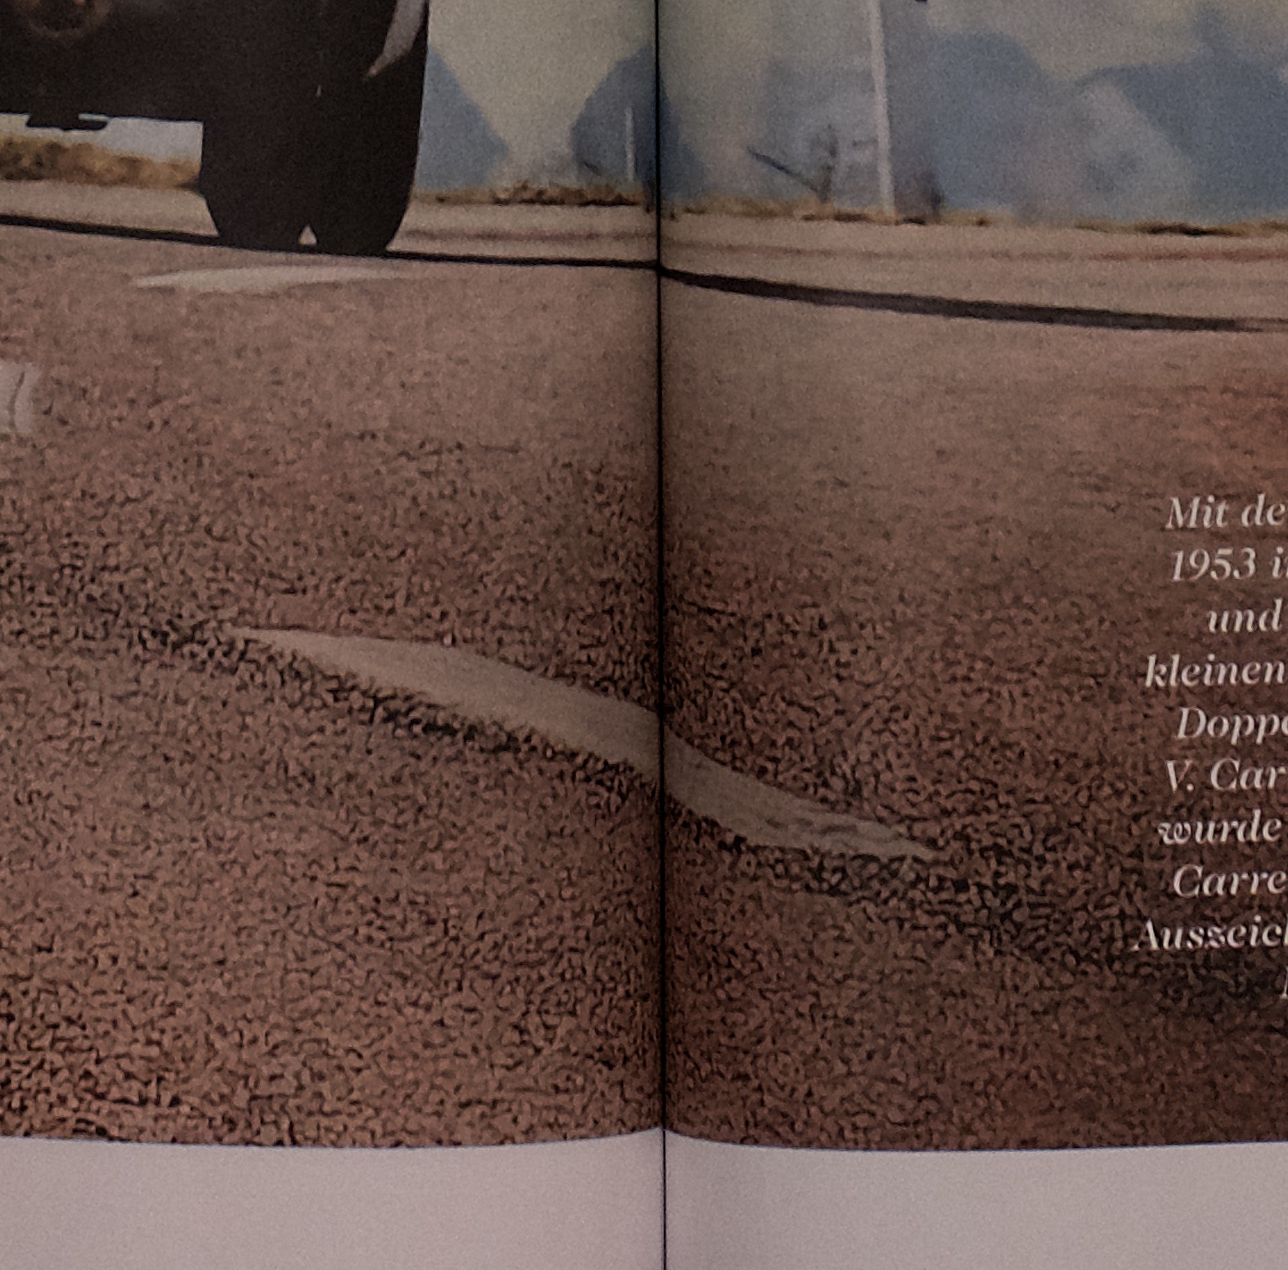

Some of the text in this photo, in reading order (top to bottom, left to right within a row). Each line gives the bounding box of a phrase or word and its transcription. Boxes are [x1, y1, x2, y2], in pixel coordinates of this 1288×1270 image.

[1165, 495, 1227, 529] Mit
[1171, 547, 1257, 581] 1953
[1208, 599, 1282, 633] und
[1145, 654, 1286, 687] kleinen
[1165, 760, 1195, 793] V.
[1158, 810, 1282, 846] wurde
